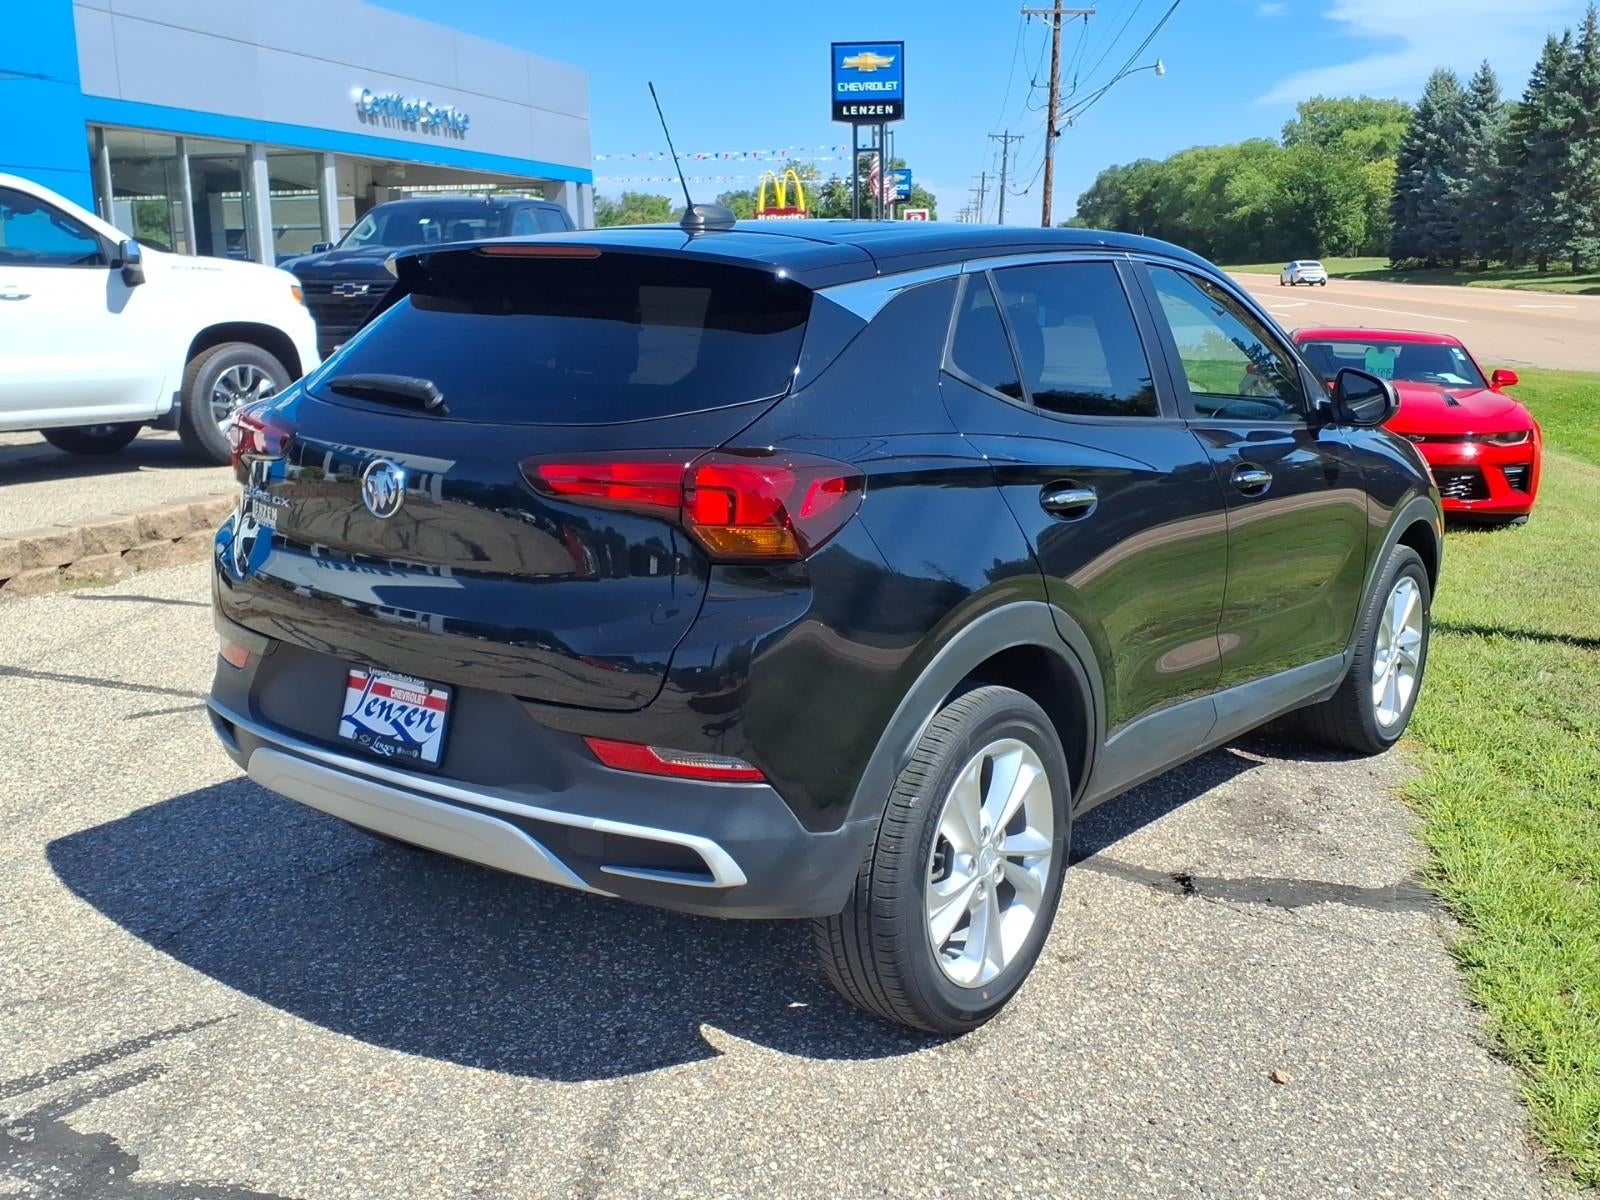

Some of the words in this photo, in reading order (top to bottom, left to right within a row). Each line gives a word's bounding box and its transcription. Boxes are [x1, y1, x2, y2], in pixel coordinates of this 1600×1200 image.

[837, 81, 898, 92] CHEVROLET
[360, 87, 420, 124] Certified
[421, 101, 470, 131] Service
[842, 105, 894, 115] LENZEN
[390, 687, 427, 705] CHEVROLET
[341, 674, 440, 745] Lenzen
